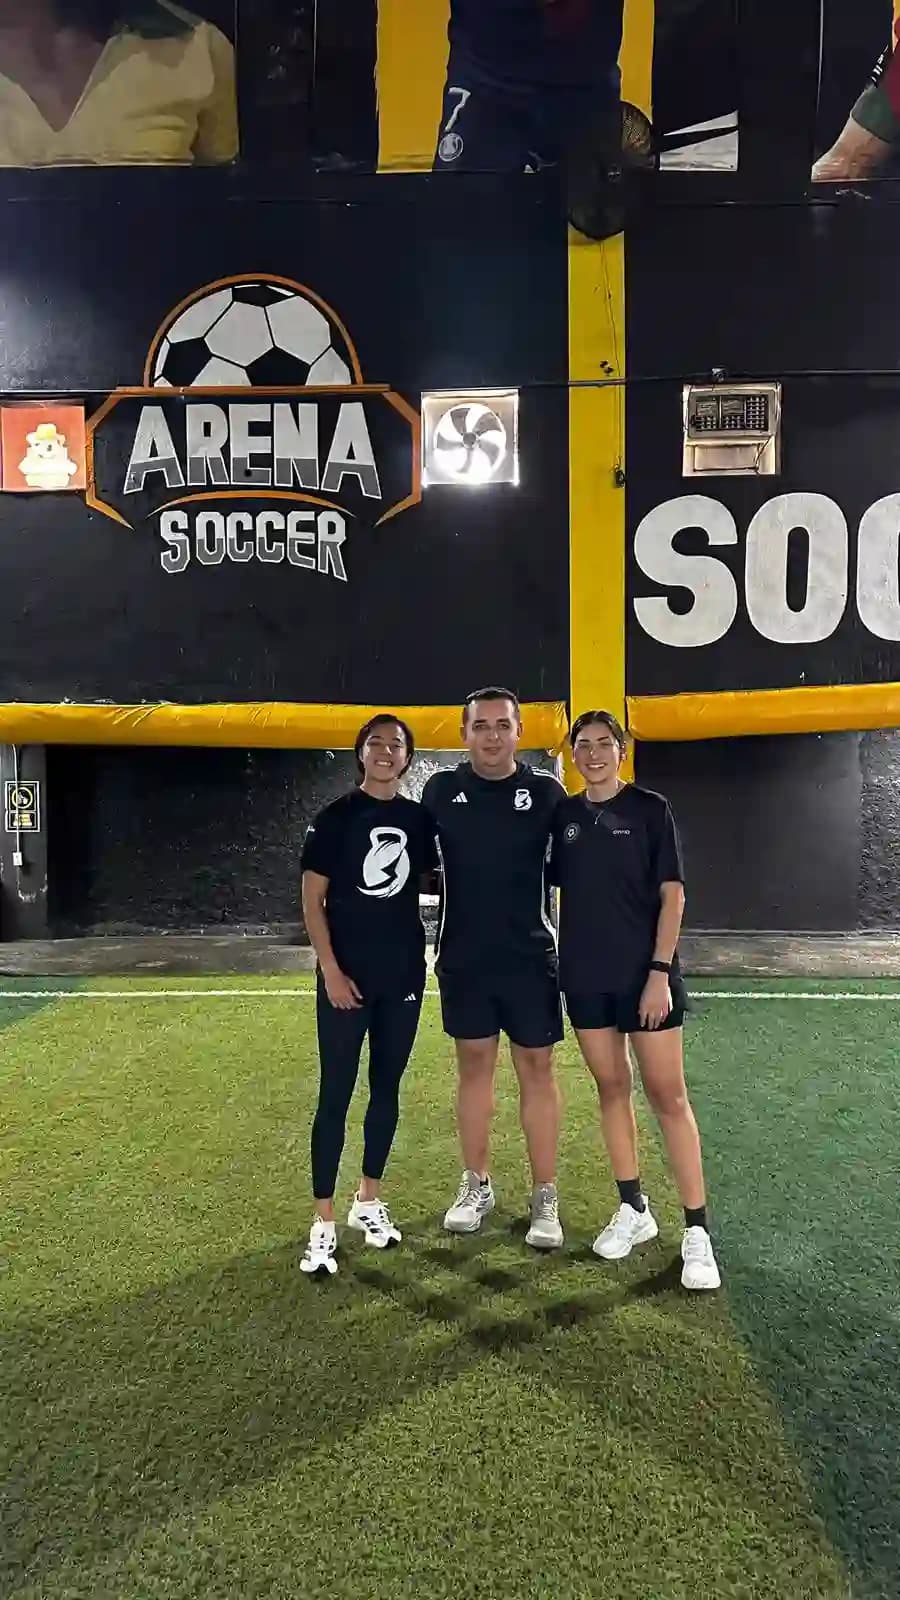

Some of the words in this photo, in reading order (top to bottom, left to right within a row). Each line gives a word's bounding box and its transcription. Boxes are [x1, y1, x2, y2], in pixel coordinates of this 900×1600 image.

[445, 86, 471, 132] 7
[124, 402, 382, 499] ARENA
[159, 510, 347, 582] SOCCER
